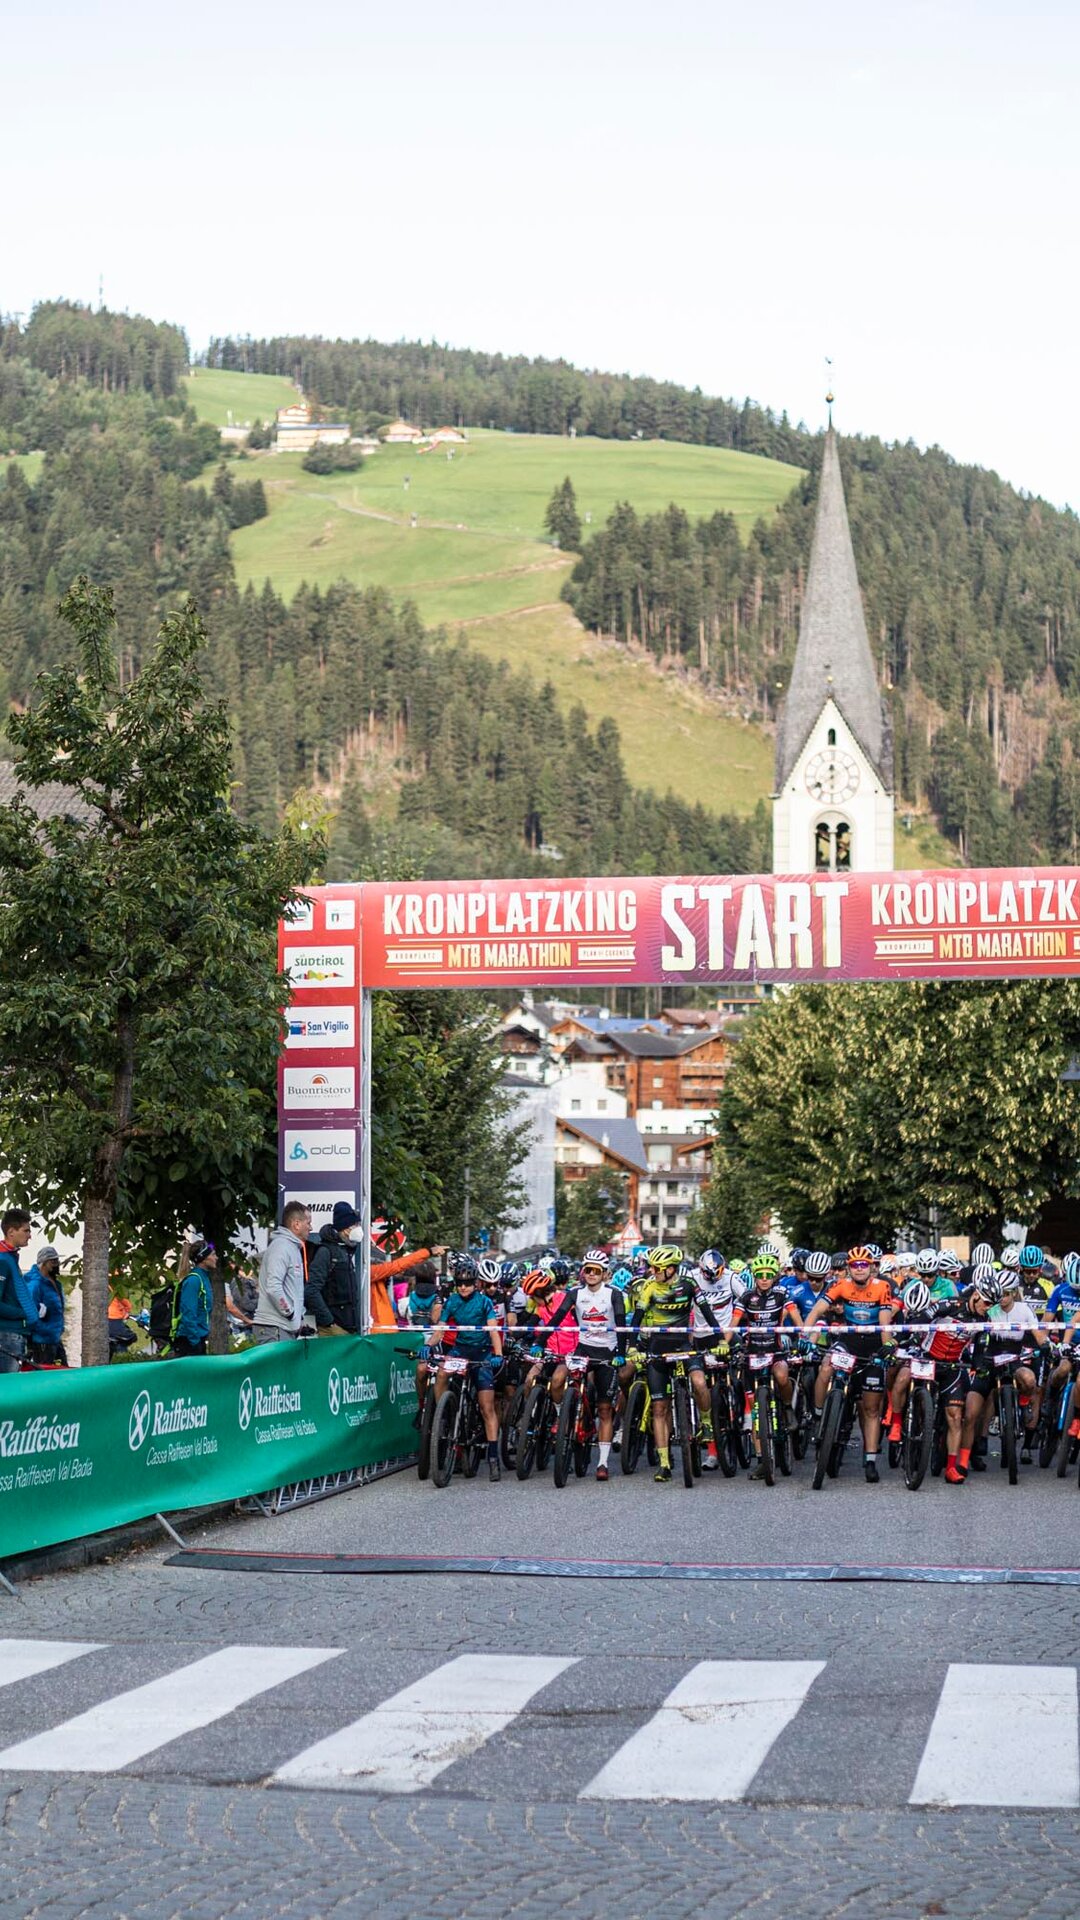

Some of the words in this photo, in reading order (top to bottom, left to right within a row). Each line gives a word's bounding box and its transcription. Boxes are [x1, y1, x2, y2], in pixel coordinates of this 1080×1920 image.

[384, 889, 637, 936] KRONPLATZKING
[871, 879, 1079, 926] KRONPLATZK
[660, 881, 849, 971] START
[447, 943, 480, 968] MTB
[484, 942, 571, 968] MARATHON
[938, 933, 973, 959] MTB
[976, 932, 1067, 958] MARATHON
[307, 1021, 322, 1031] San
[323, 1020, 349, 1034] Vigilio
[288, 1086, 351, 1095] Buonristoro
[310, 1144, 351, 1155] odlo
[307, 1203, 333, 1212] MIAR
[654, 1301, 689, 1310] SCOTT
[836, 1355, 849, 1365] 102
[254, 1384, 301, 1417] Raiffeisen
[151, 1397, 208, 1436] Raiffeisen
[0, 1415, 81, 1457] Raiffeisen
[254, 1426, 272, 1444] Cassa
[146, 1446, 168, 1466] Cassa
[168, 1441, 194, 1462] Raiffeisen
[203, 1436, 218, 1455] Badia
[14, 1464, 57, 1489] Raiffeisen
[58, 1460, 72, 1480] Val
[70, 1457, 93, 1479] Badia
